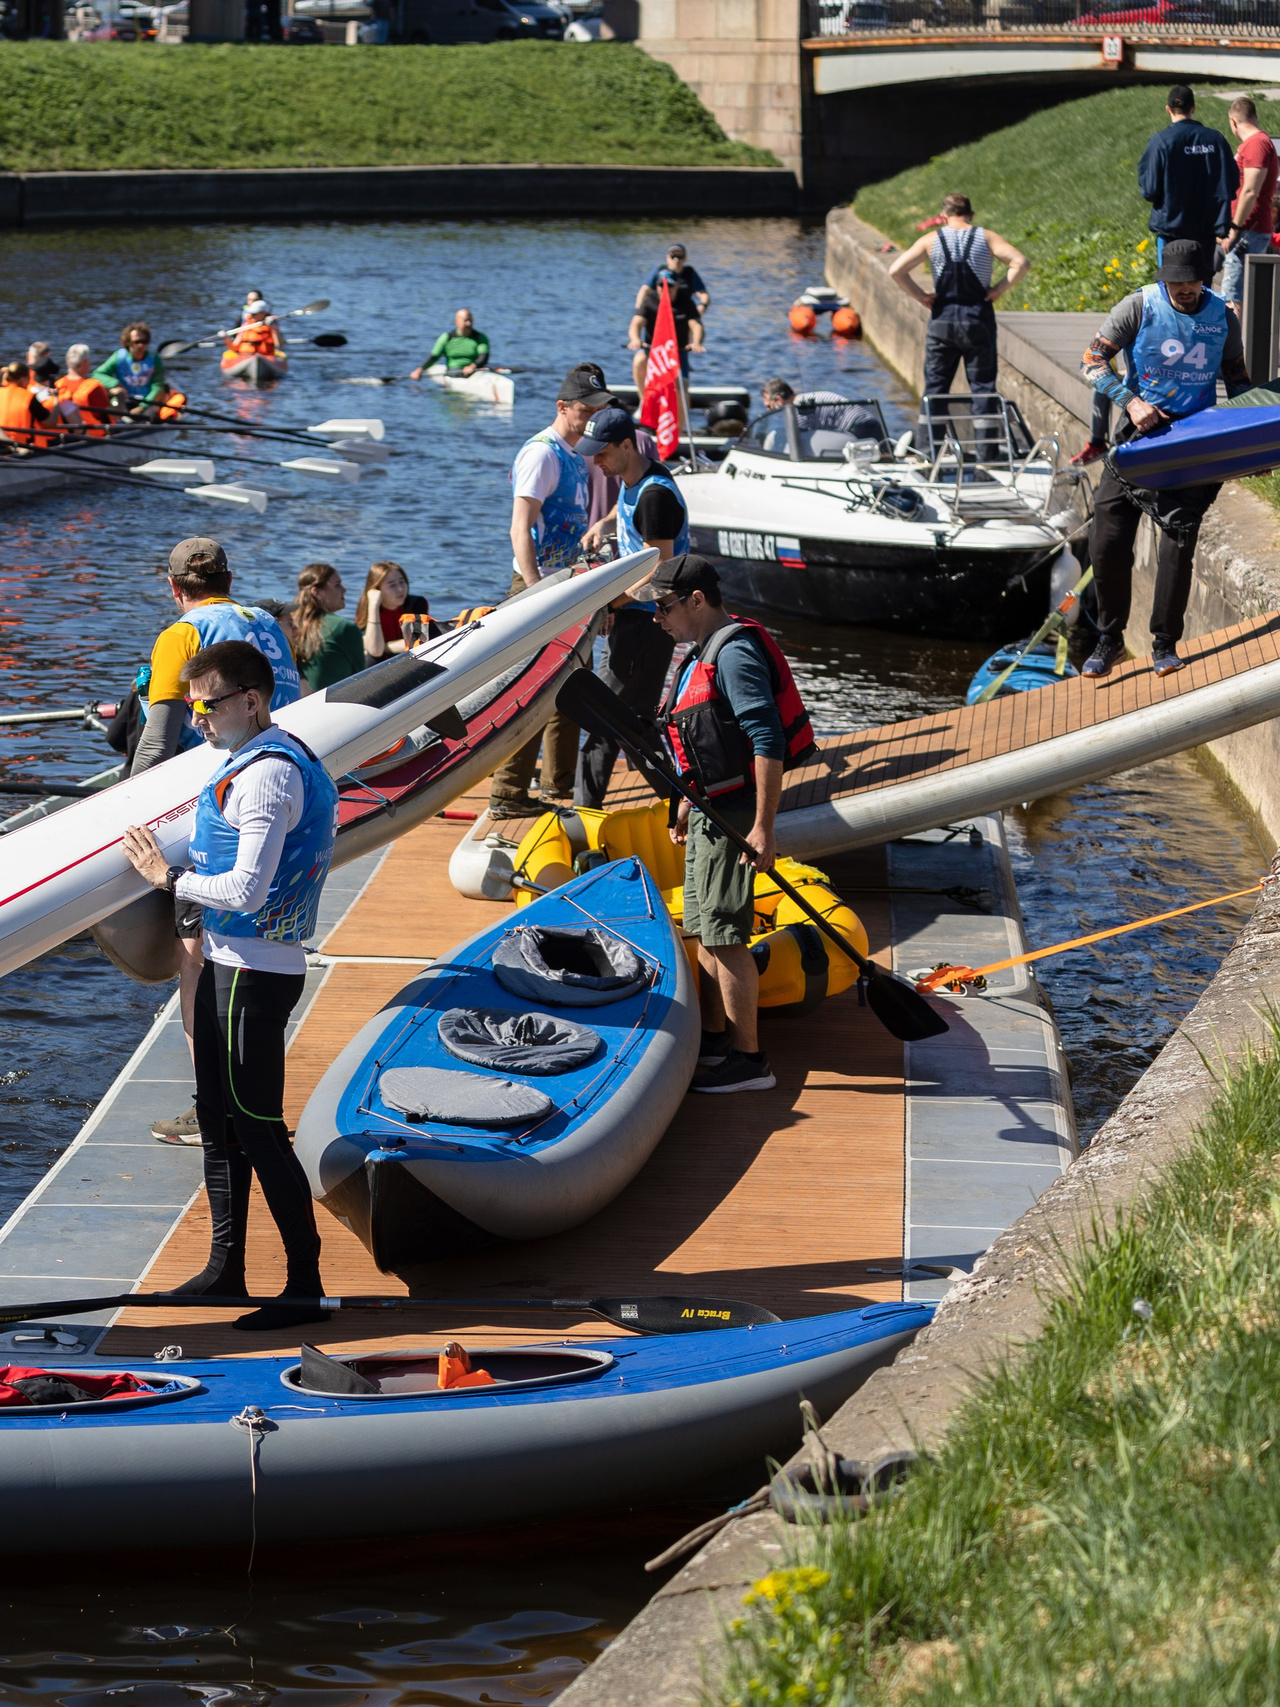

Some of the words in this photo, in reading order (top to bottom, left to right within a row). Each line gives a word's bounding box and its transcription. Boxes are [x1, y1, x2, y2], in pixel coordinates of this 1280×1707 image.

[1183, 144, 1215, 155] СУДЬЯ
[1160, 338, 1208, 370] 94
[1144, 365, 1215, 382] WATERPOINT
[680, 1308, 695, 1318] IV
